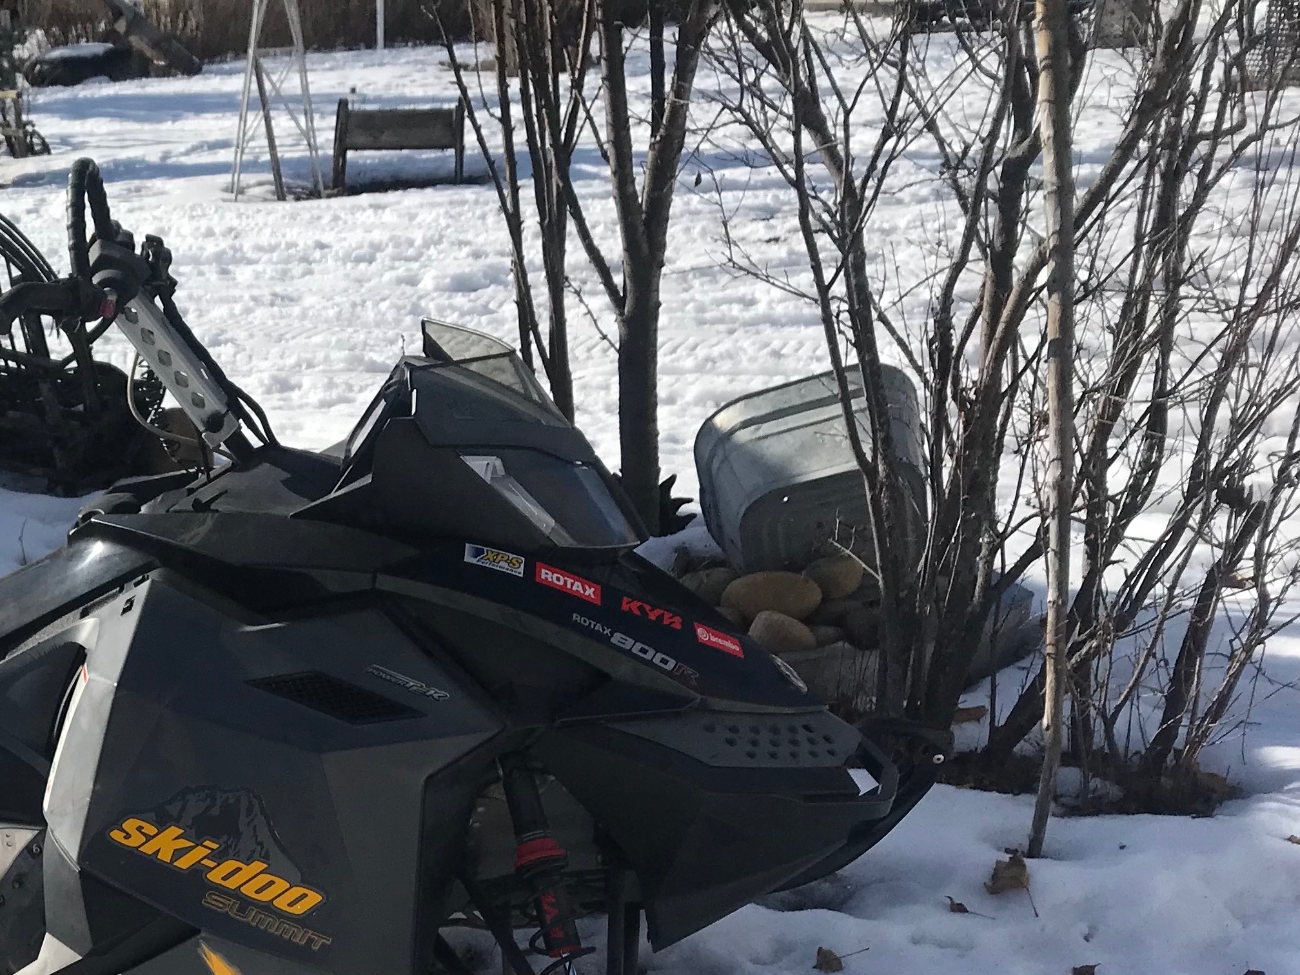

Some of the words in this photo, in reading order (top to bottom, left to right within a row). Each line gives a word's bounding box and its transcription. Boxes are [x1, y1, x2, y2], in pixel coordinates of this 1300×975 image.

[540, 568, 596, 599] ROTAX
[572, 613, 612, 637] ROTAX
[709, 632, 740, 652] brembo
[202, 891, 332, 951] SUMMIT
